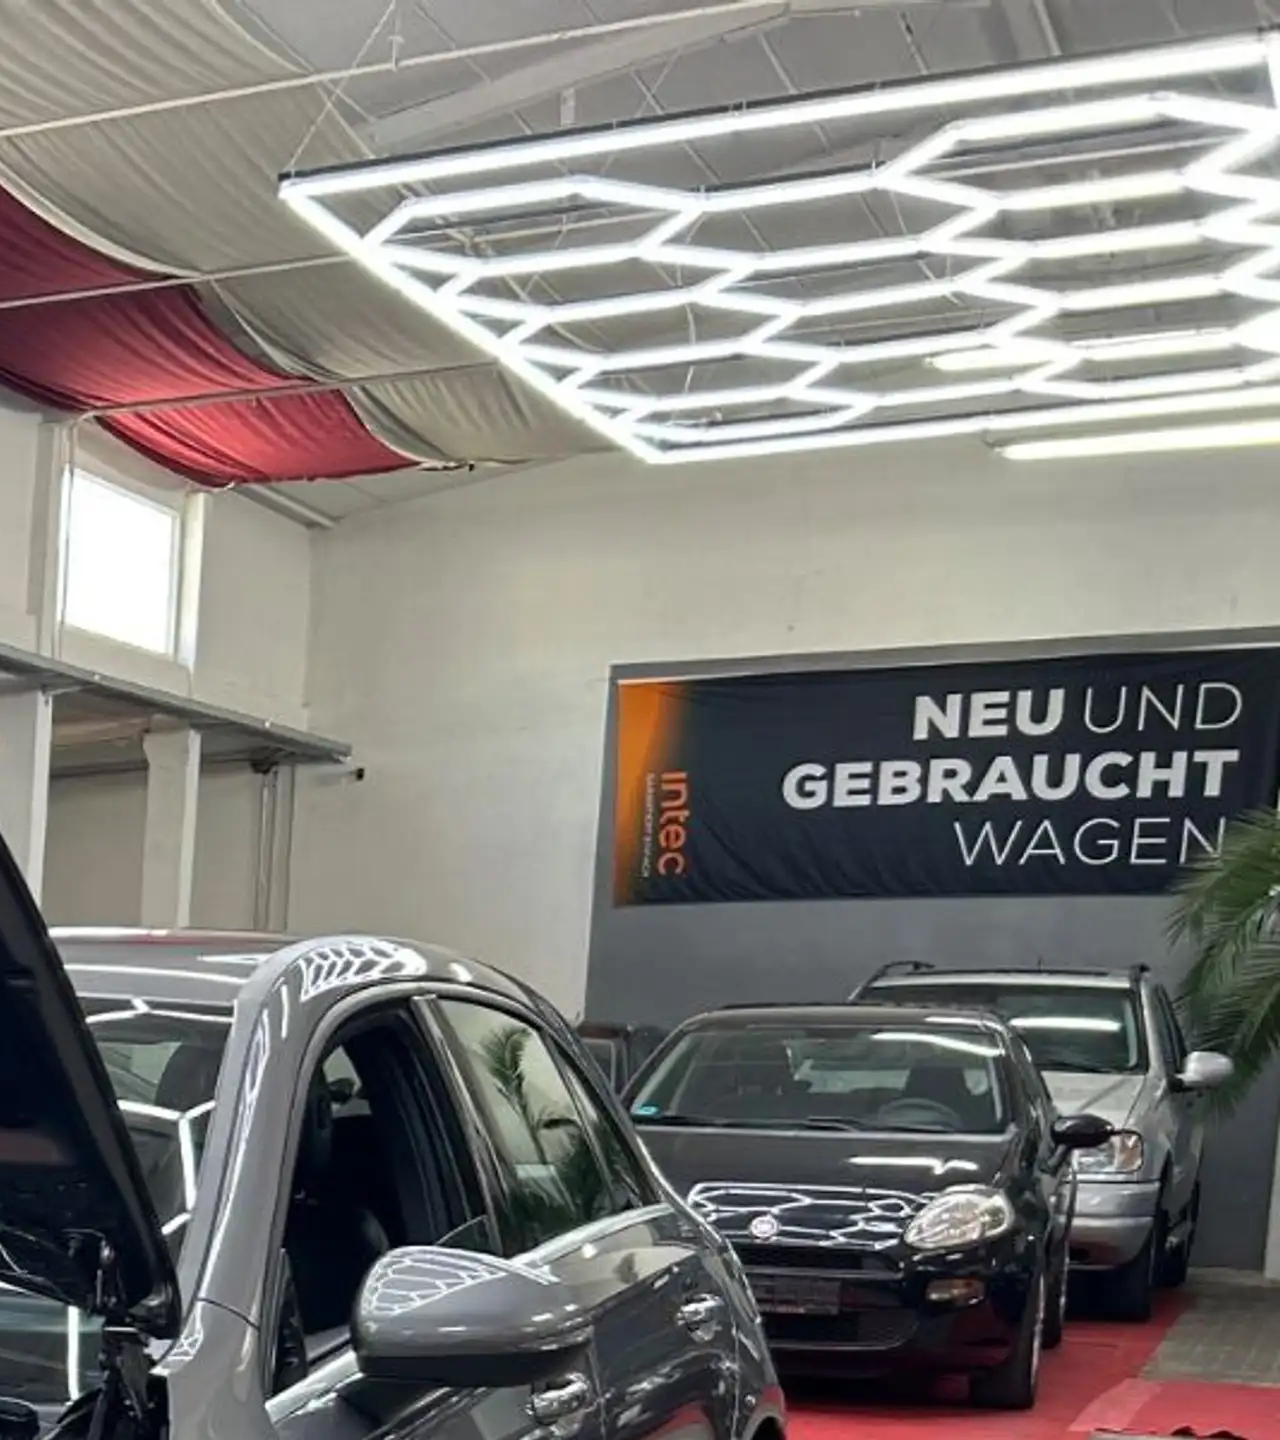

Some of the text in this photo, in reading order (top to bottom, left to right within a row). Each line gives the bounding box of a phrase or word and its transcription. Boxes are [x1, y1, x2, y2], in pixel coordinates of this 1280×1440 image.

[912, 682, 1243, 741] NEU UND
[782, 749, 1240, 810] GEBRAUCHT
[953, 816, 1227, 866] WAGEN
